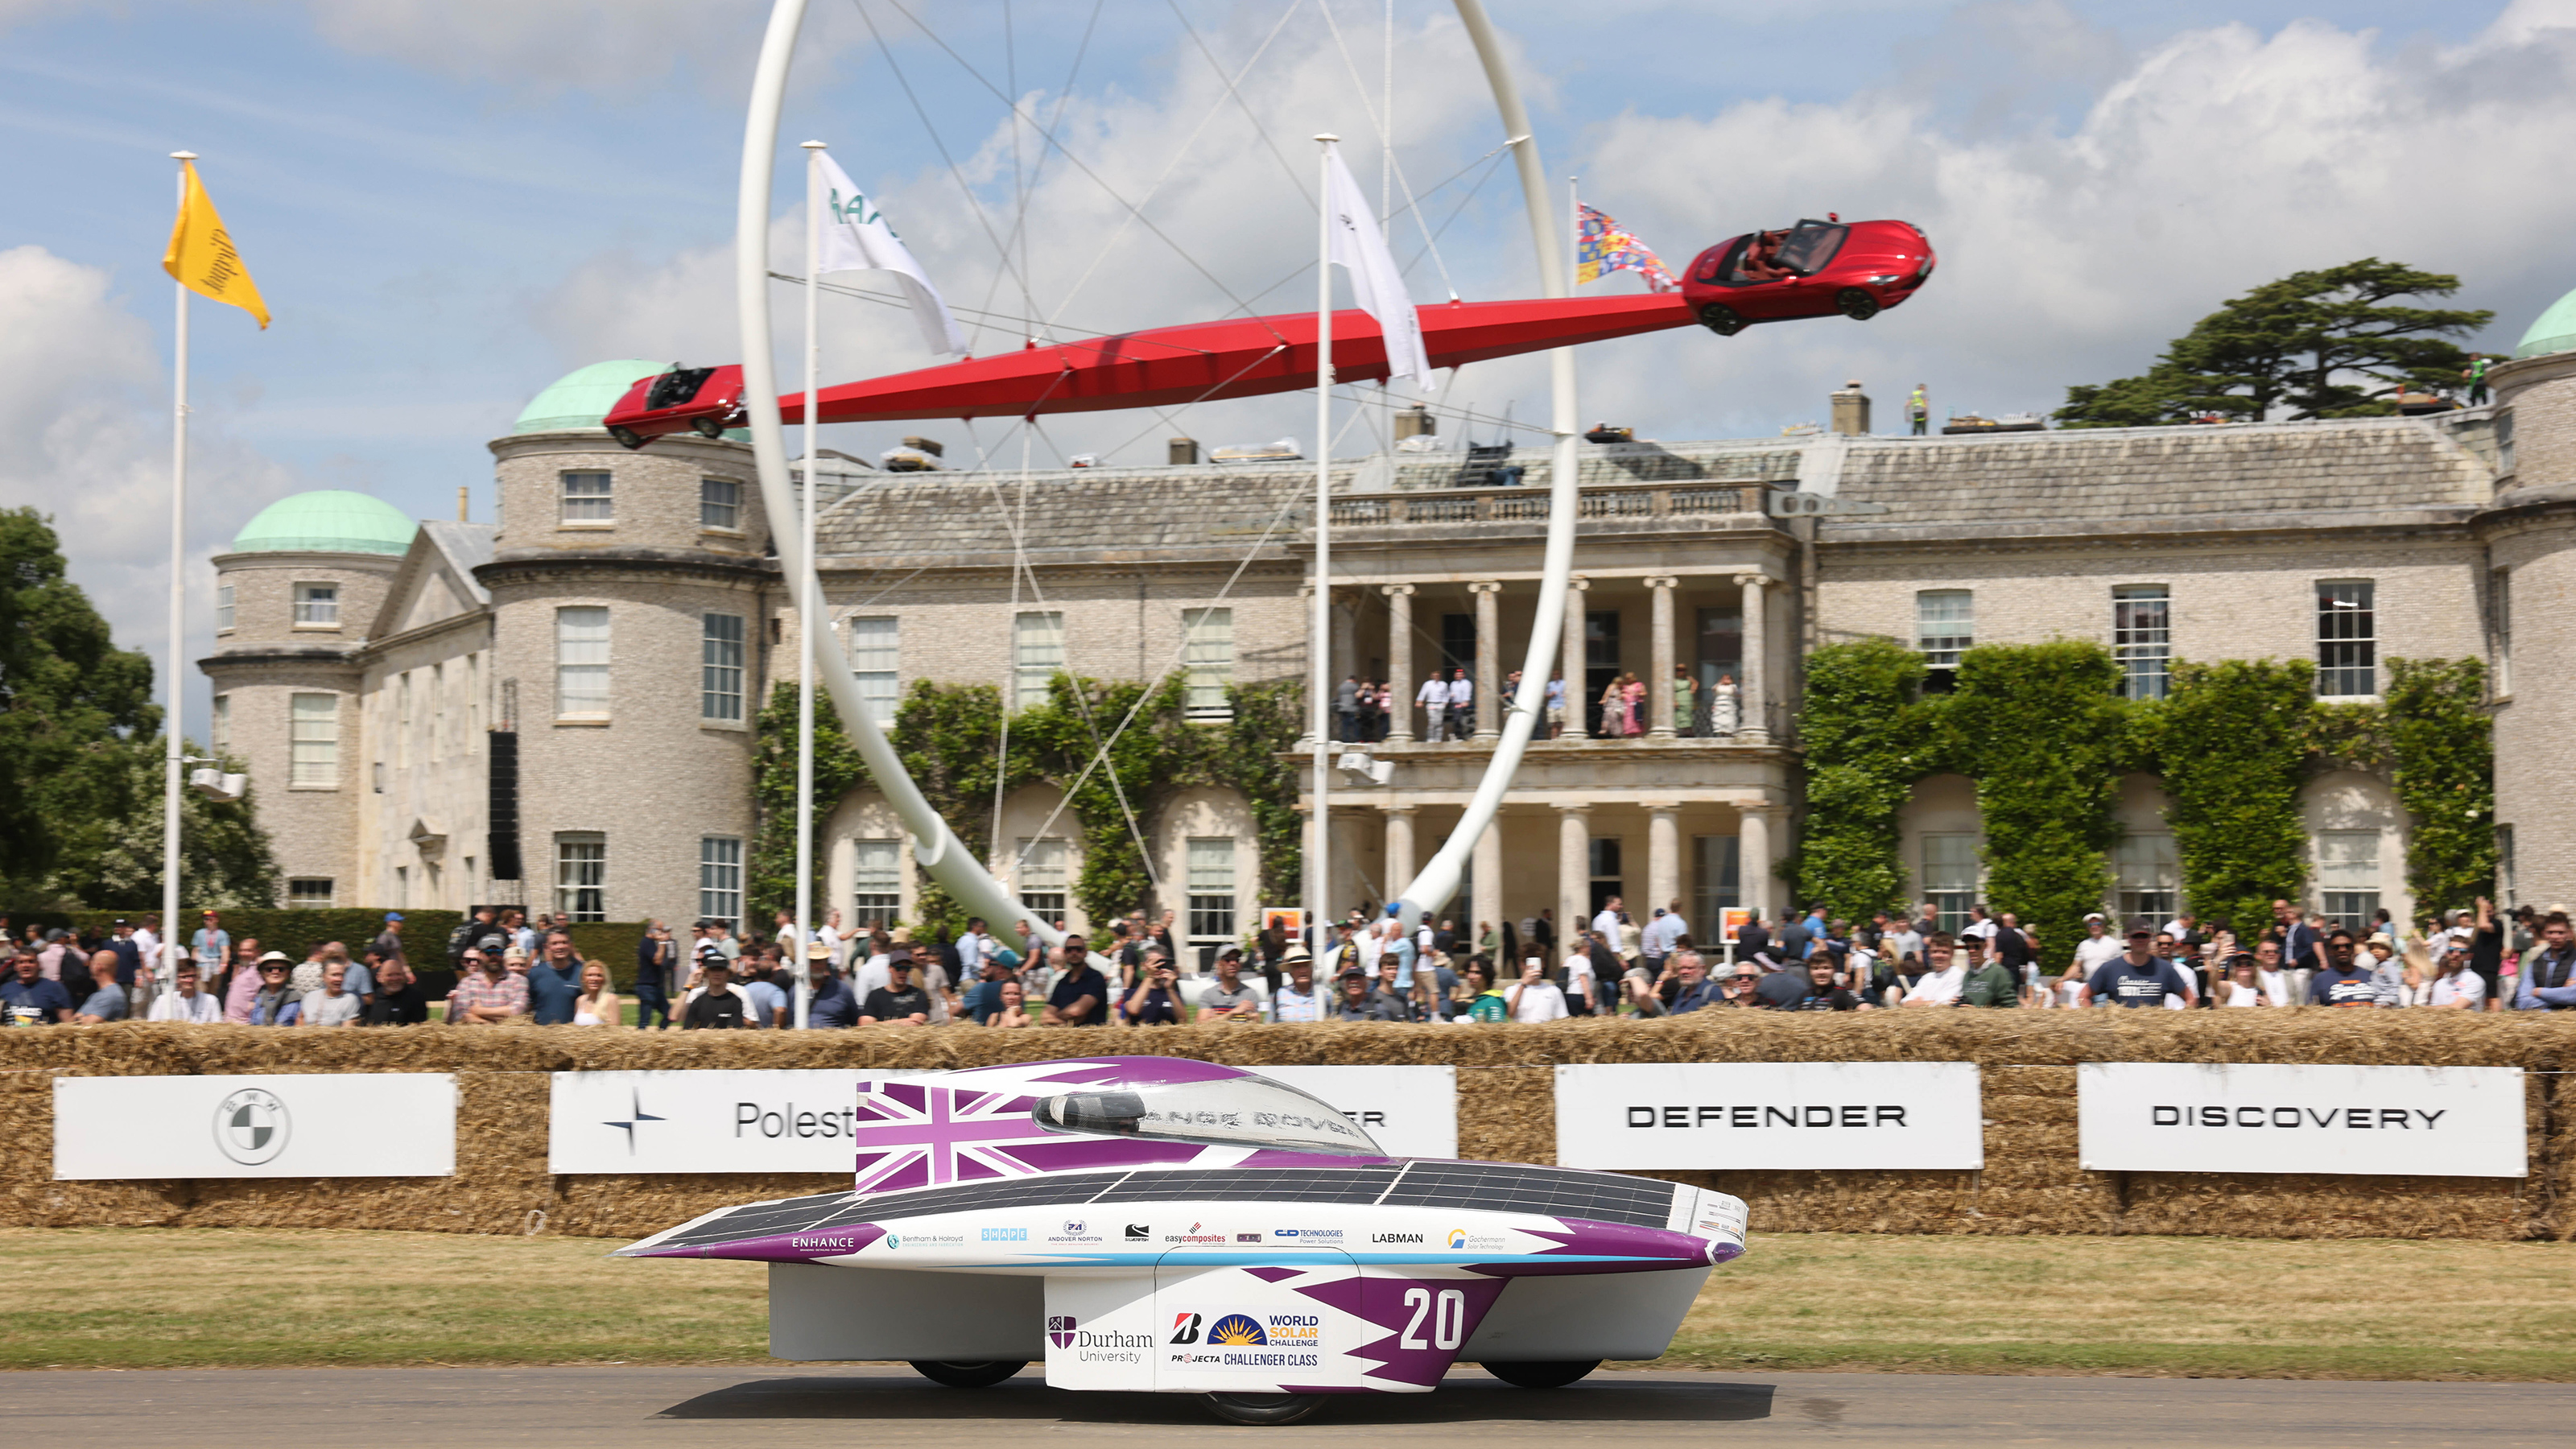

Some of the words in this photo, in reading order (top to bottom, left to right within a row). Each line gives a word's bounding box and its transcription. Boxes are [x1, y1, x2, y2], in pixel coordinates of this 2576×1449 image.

[736, 1101, 855, 1138] Polest
[1142, 1108, 1243, 1129] ANGE
[1626, 1105, 1909, 1128] DEFENDER
[2152, 1105, 2448, 1129] DISCOVERY
[939, 1235, 964, 1243] Holroyd
[982, 1229, 1026, 1240] SHAPE
[1165, 1233, 1226, 1244] easycomposites
[1300, 1229, 1344, 1237] TECHNOLOGIES
[1372, 1233, 1424, 1243] LABMAN
[1469, 1235, 1505, 1243] Gochermann
[792, 1237, 854, 1248] ENHANCE
[1269, 1315, 1319, 1327] WORLD
[1400, 1287, 1464, 1350] 20
[1078, 1330, 1154, 1348] Durham
[1269, 1327, 1319, 1339] SOLAR
[1080, 1350, 1141, 1364] University
[1224, 1353, 1286, 1366] CHALLENGER
[1288, 1354, 1318, 1366] CLASS
